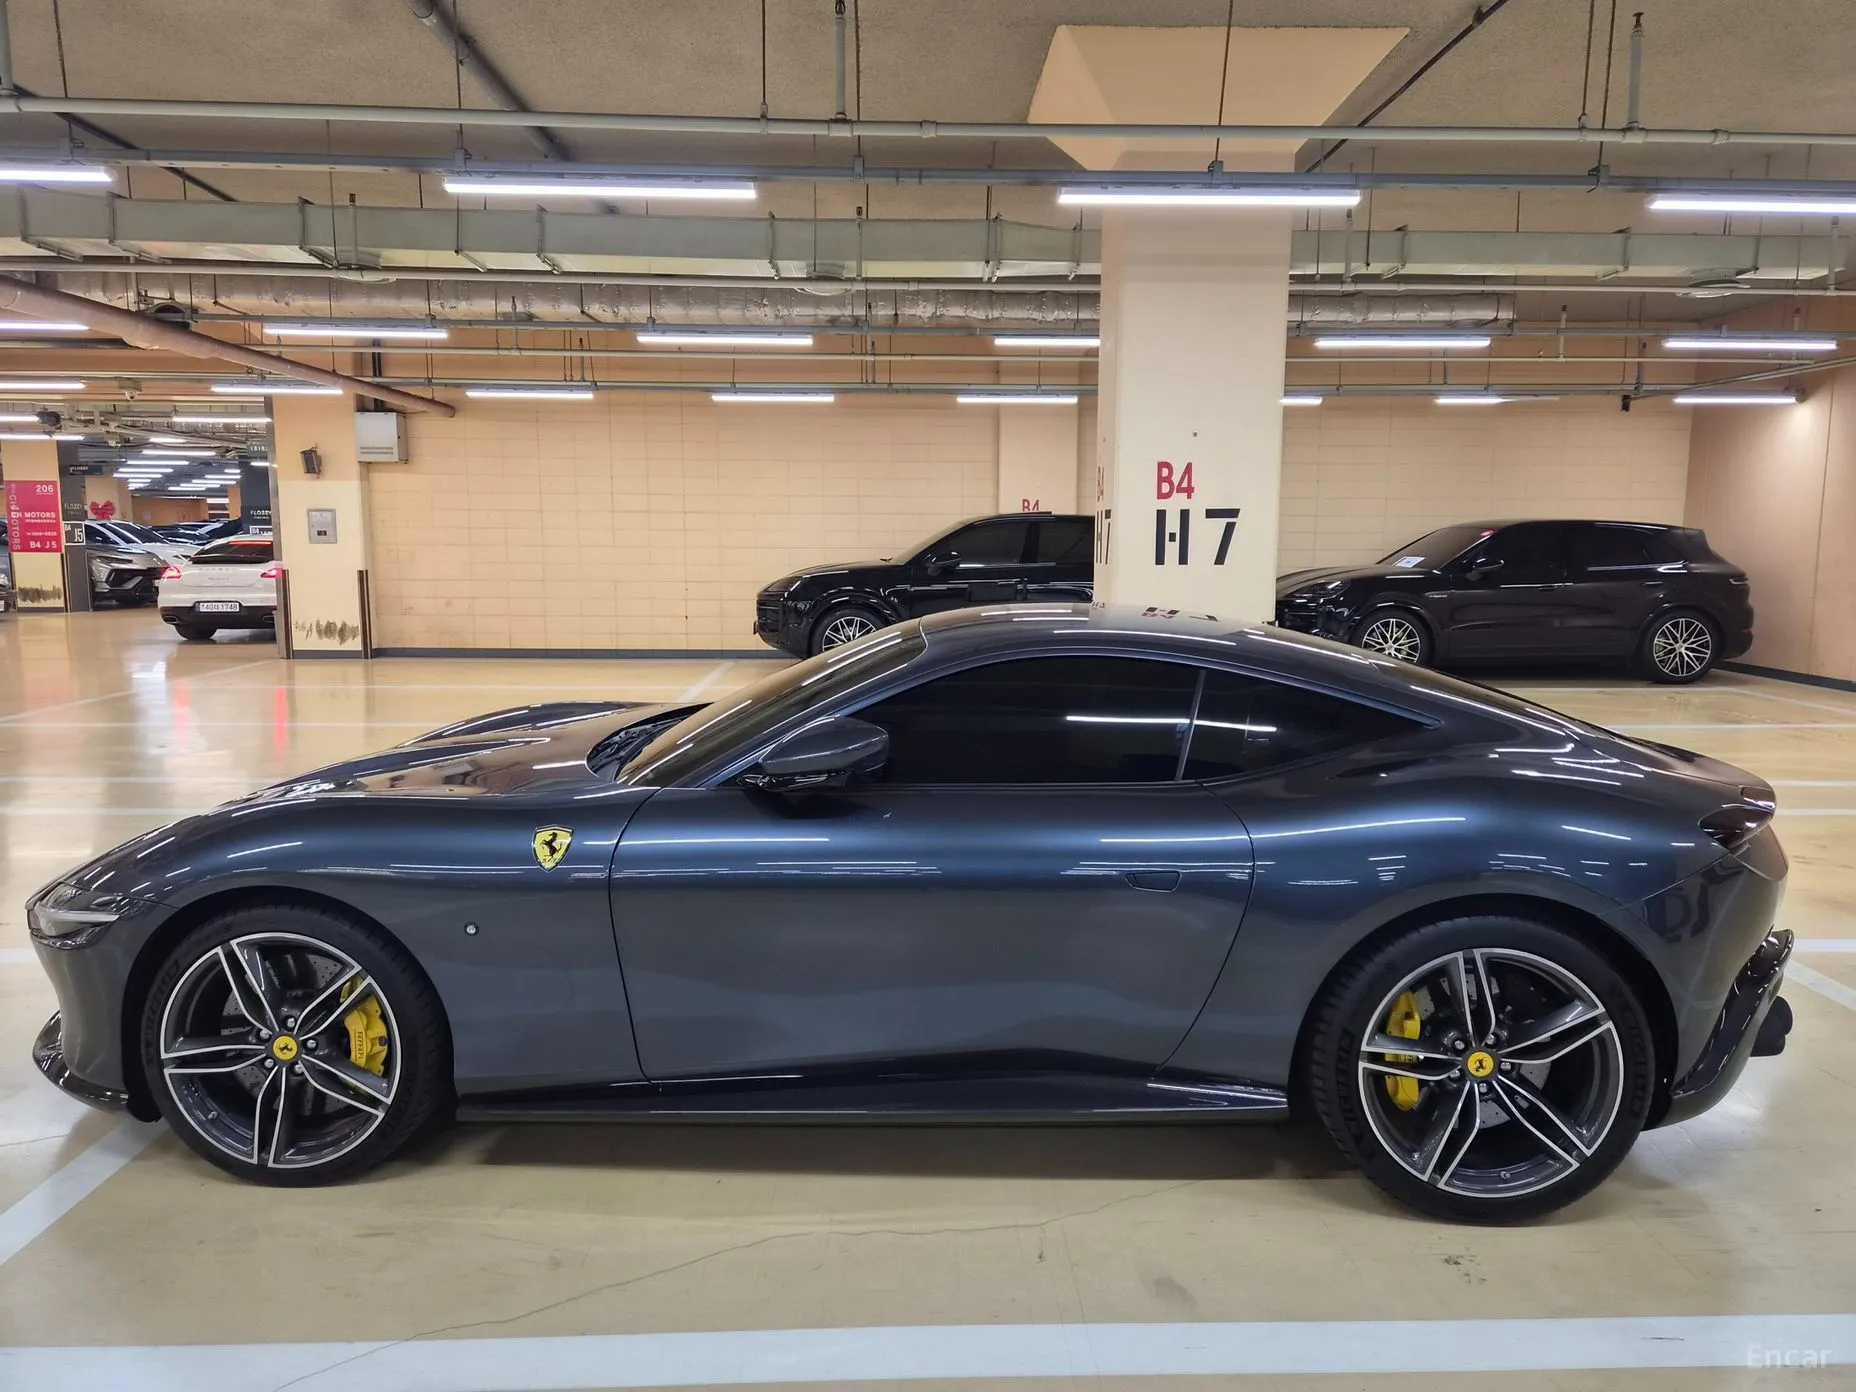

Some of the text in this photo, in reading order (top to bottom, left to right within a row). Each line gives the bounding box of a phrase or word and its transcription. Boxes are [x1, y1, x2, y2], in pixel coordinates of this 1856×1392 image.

[1156, 461, 1195, 500] B4
[36, 484, 54, 493] 206
[1022, 498, 1040, 511] B4
[74, 528, 83, 542] J5
